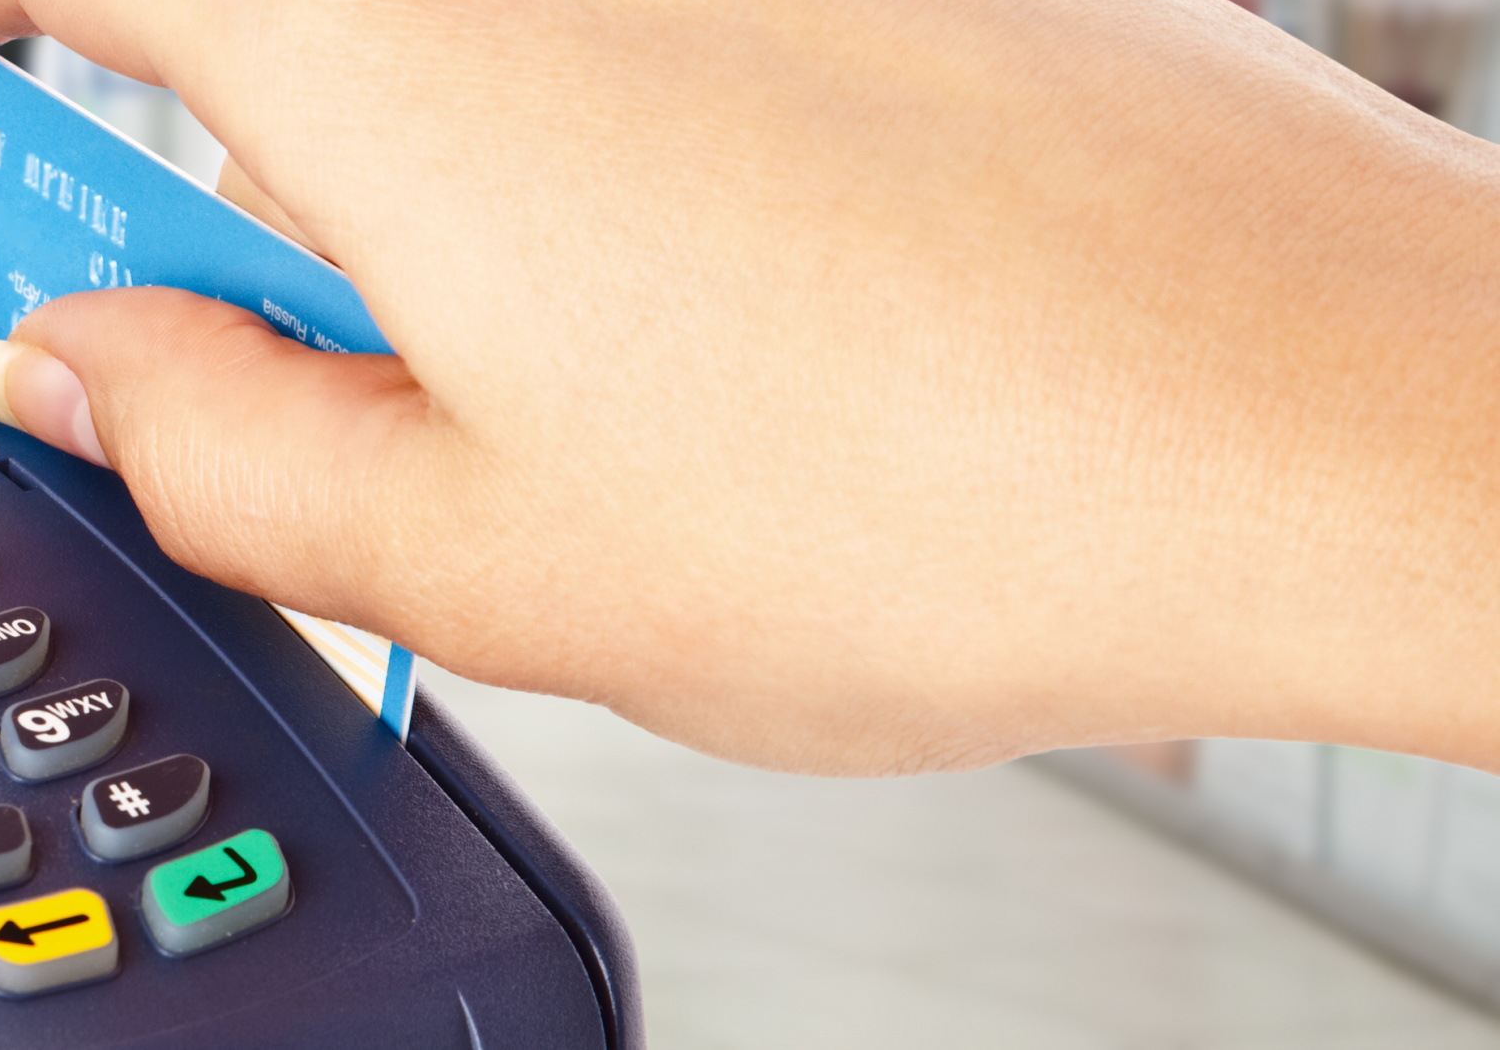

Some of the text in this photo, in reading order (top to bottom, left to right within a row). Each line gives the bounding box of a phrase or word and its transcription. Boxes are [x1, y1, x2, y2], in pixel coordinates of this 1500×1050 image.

[263, 297, 308, 342] Russia
[17, 691, 113, 743] 9 WXY
